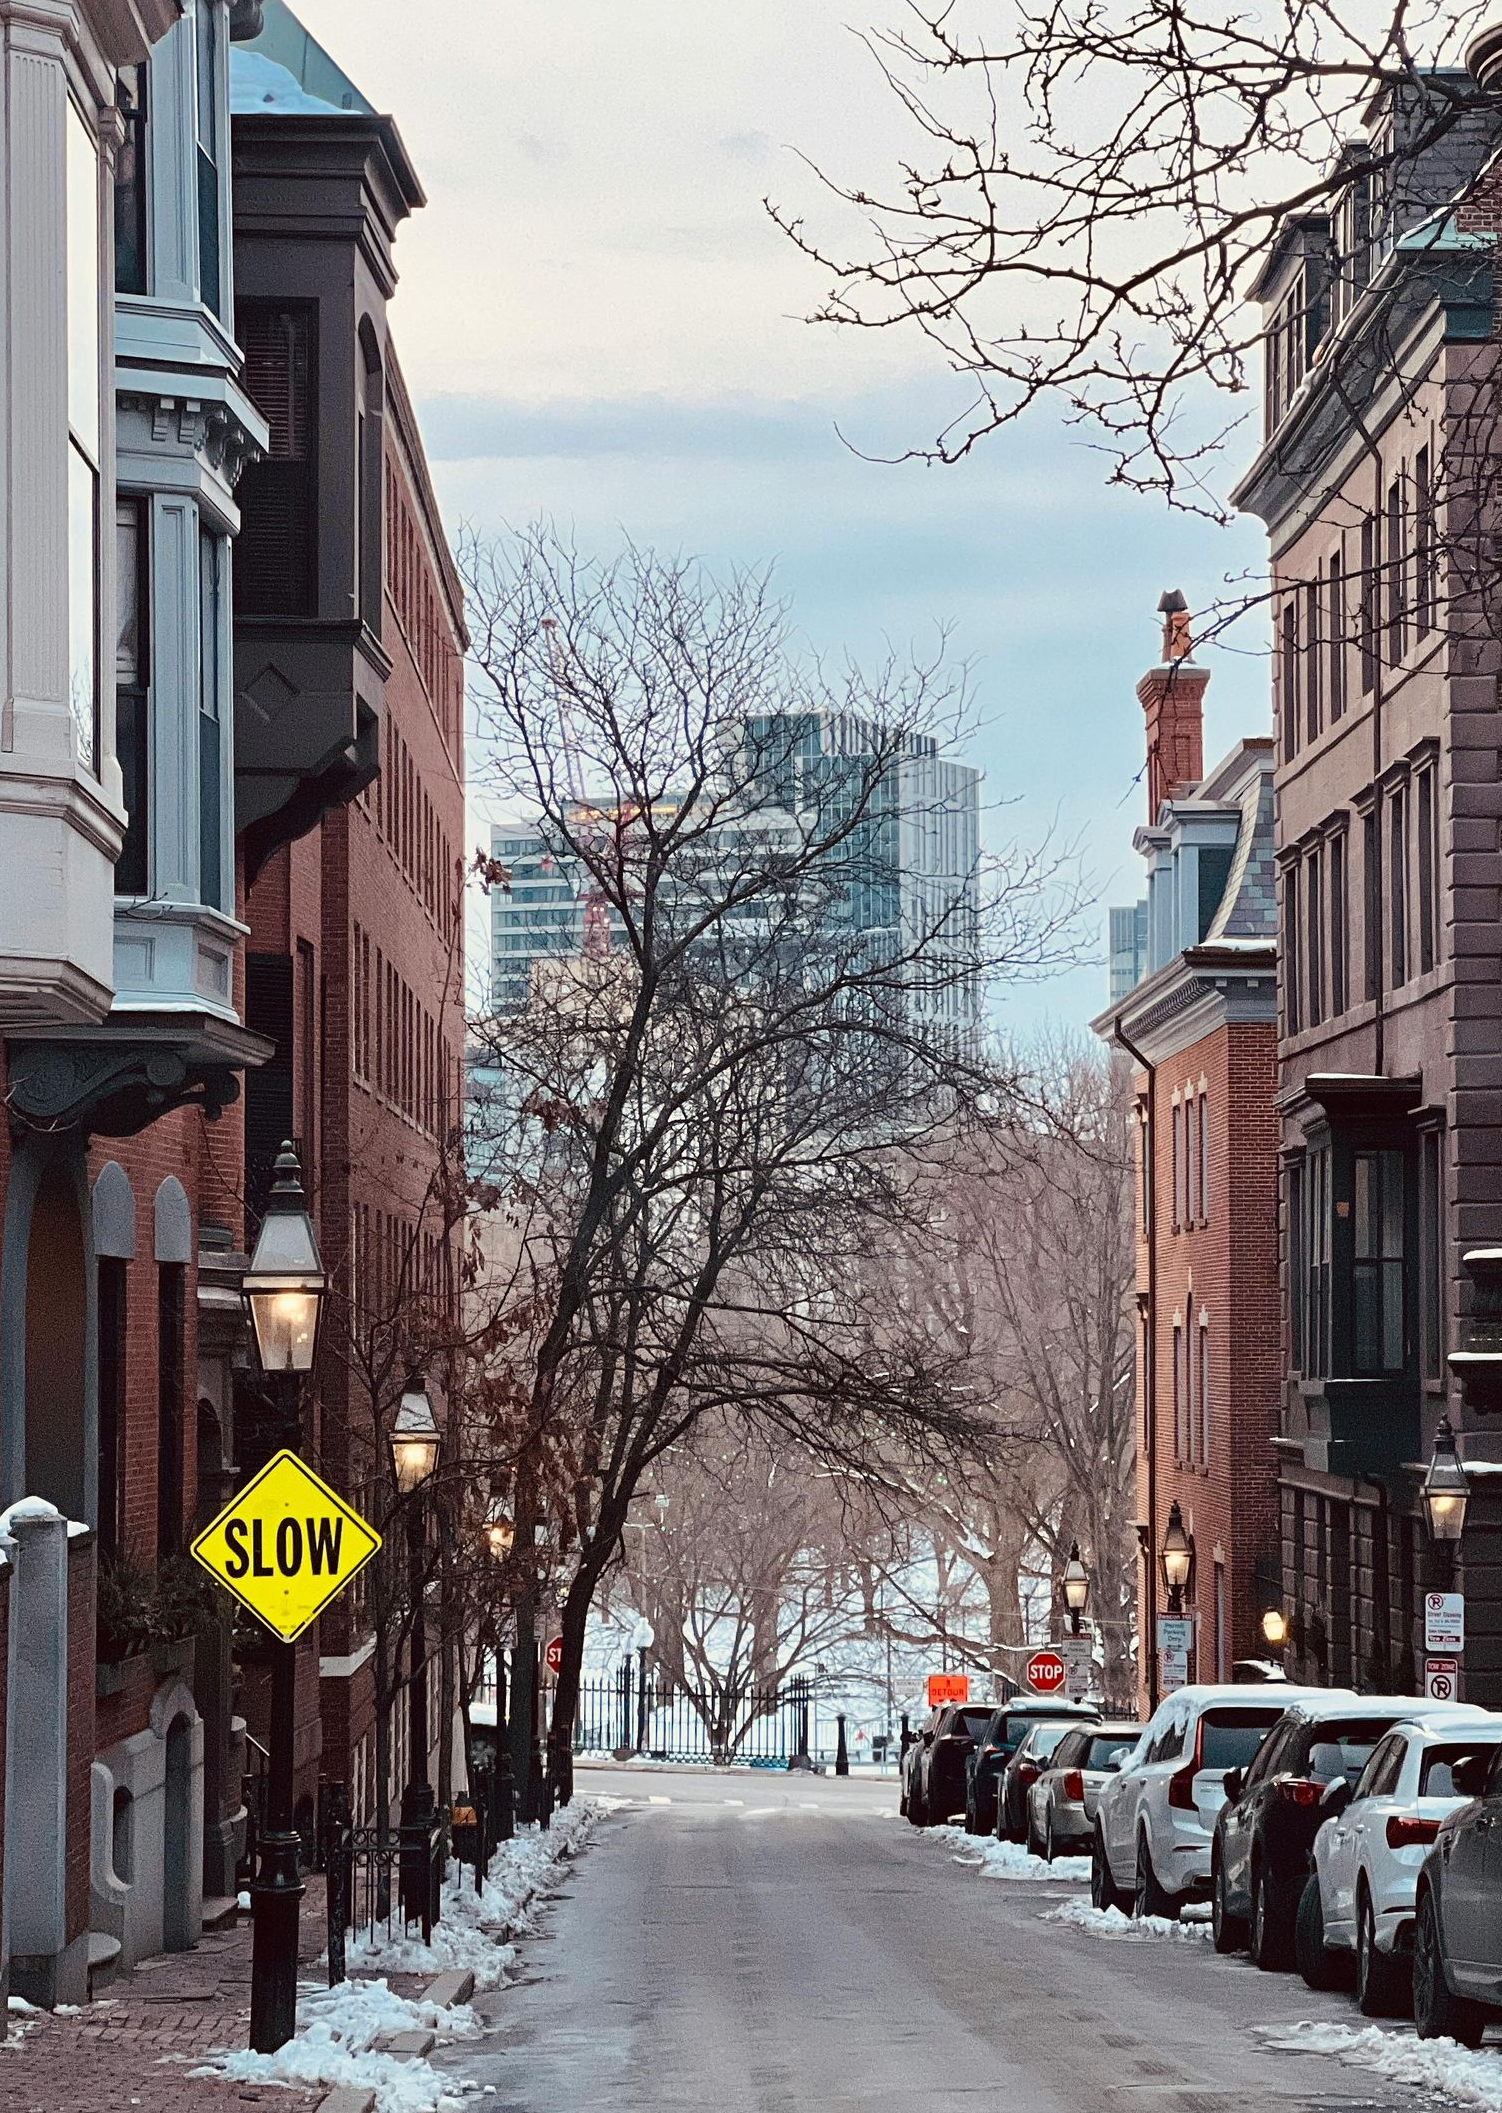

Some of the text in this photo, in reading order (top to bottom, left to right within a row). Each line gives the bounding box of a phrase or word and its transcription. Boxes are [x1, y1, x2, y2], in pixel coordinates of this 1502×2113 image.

[224, 1517, 343, 1579] SLOW
[548, 1647, 562, 1662] ST
[1029, 1664, 1063, 1680] STOP
[931, 1688, 965, 1697] DETOUR
